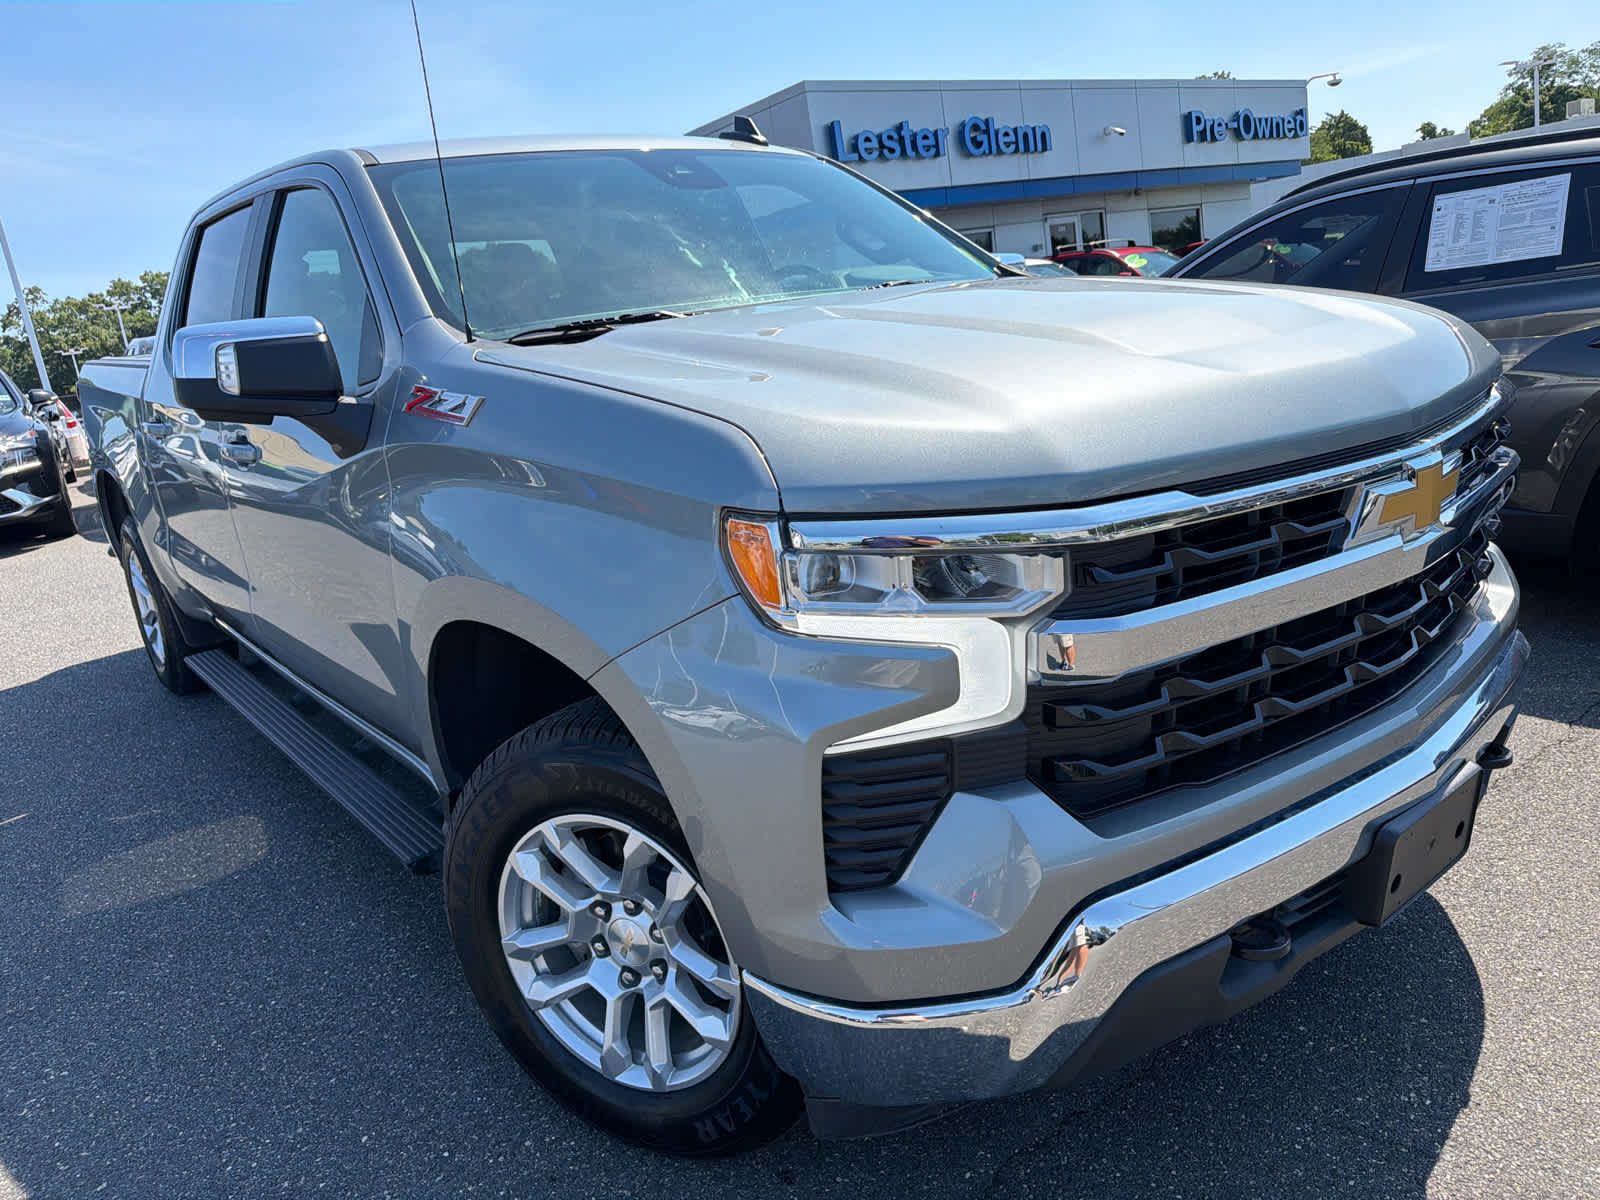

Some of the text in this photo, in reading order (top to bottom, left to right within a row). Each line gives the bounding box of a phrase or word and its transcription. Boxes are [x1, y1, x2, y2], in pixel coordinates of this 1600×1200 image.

[827, 115, 1052, 162] Lester Glenn
[1185, 107, 1308, 143] Pre-Owned
[401, 383, 487, 428] Z71
